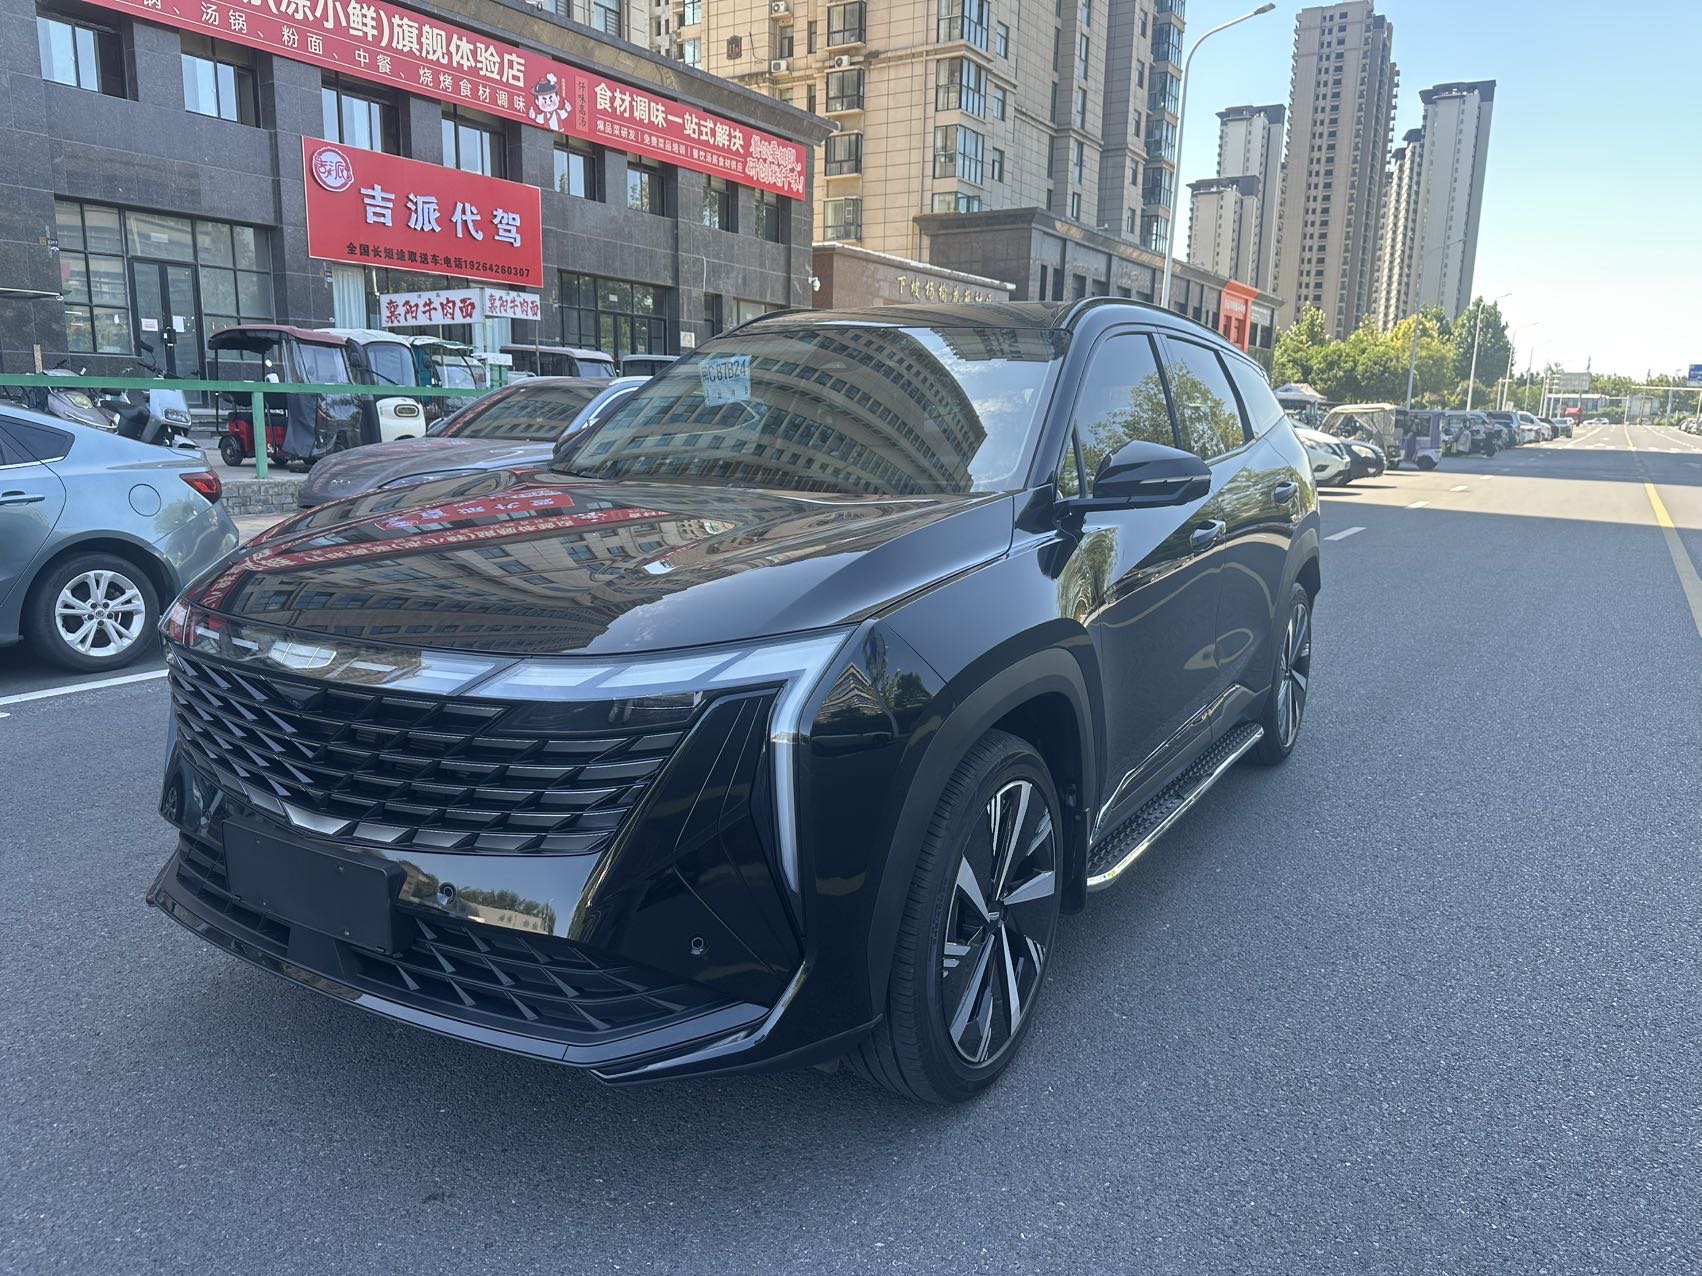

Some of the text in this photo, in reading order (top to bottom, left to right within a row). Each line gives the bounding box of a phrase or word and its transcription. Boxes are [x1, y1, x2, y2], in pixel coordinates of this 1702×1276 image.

[243, 0, 526, 87] (冻小鲜)旗舰体验店
[594, 82, 744, 154] 食材调味一站式解决
[360, 184, 521, 247] 吉派代驾
[385, 296, 476, 325] 襄阳牛肉面
[487, 293, 540, 317] 襄阳牛肉面
